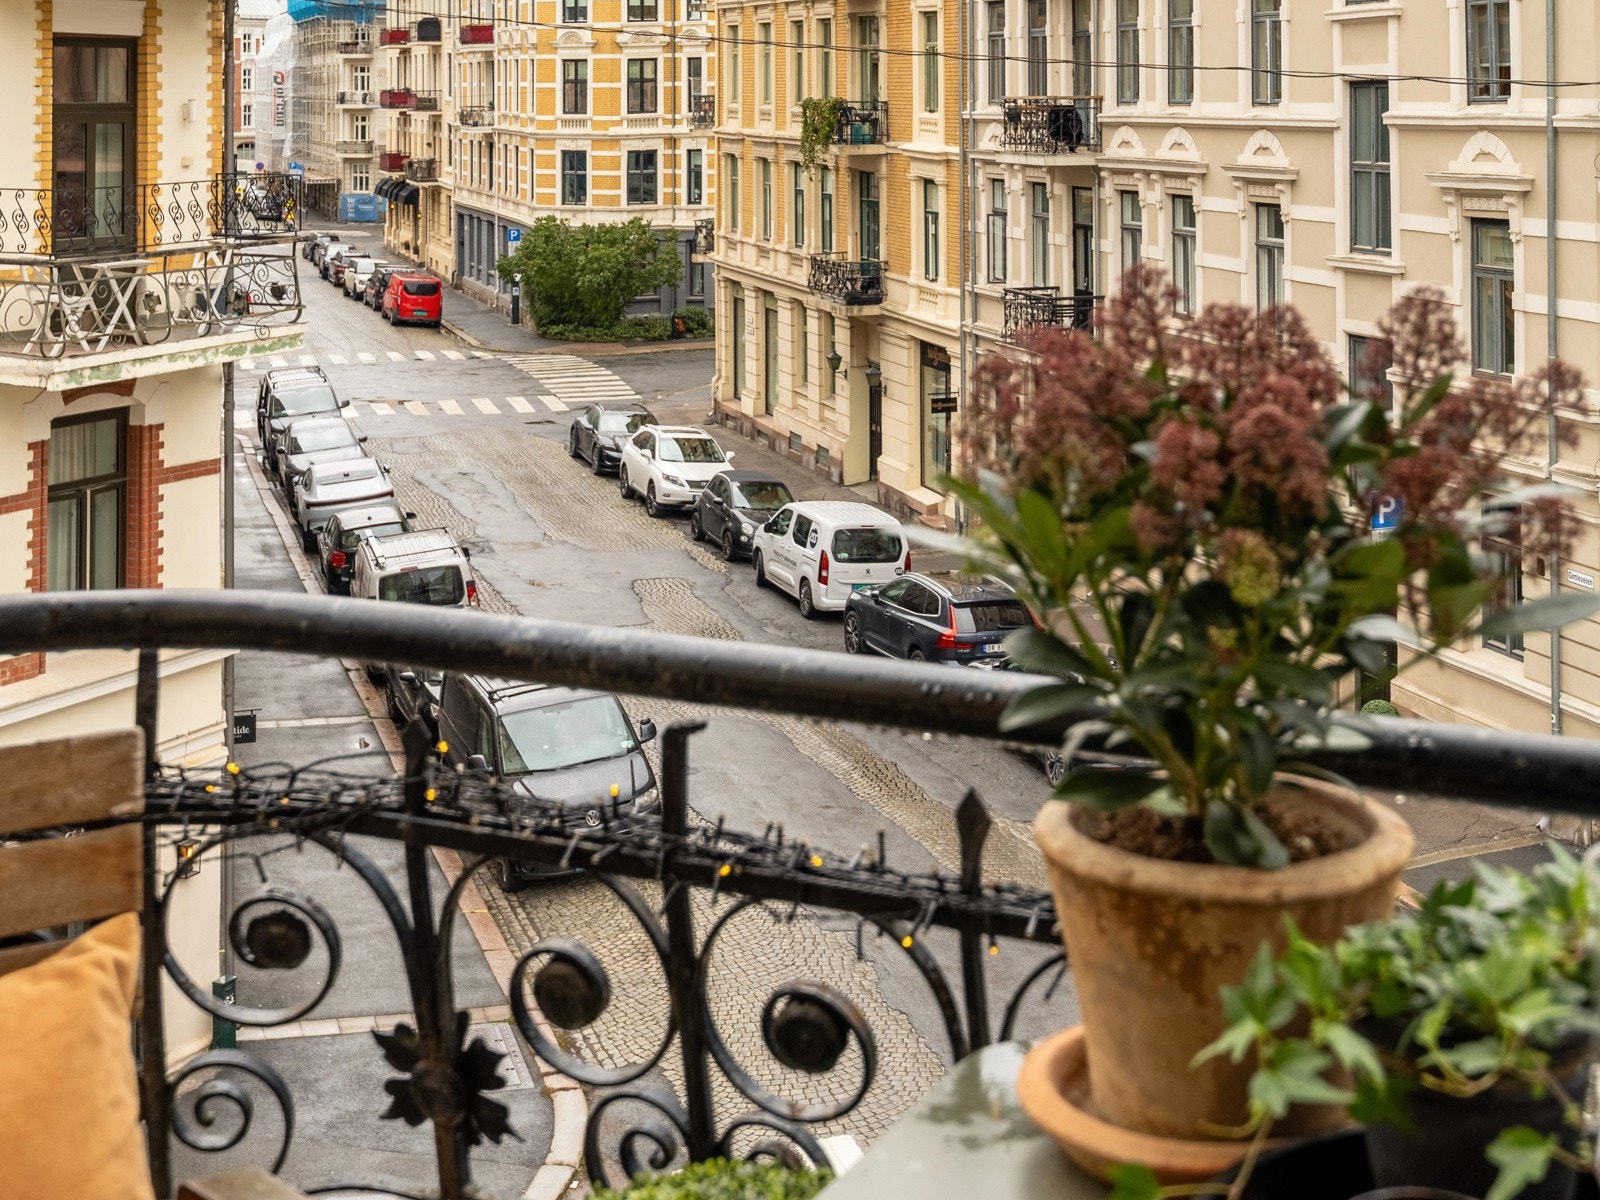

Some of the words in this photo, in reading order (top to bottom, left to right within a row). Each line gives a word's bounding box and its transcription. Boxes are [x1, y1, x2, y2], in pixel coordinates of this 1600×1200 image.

[510, 230, 518, 241] P
[1378, 495, 1396, 524] P
[1568, 570, 1593, 587] Gimleveien
